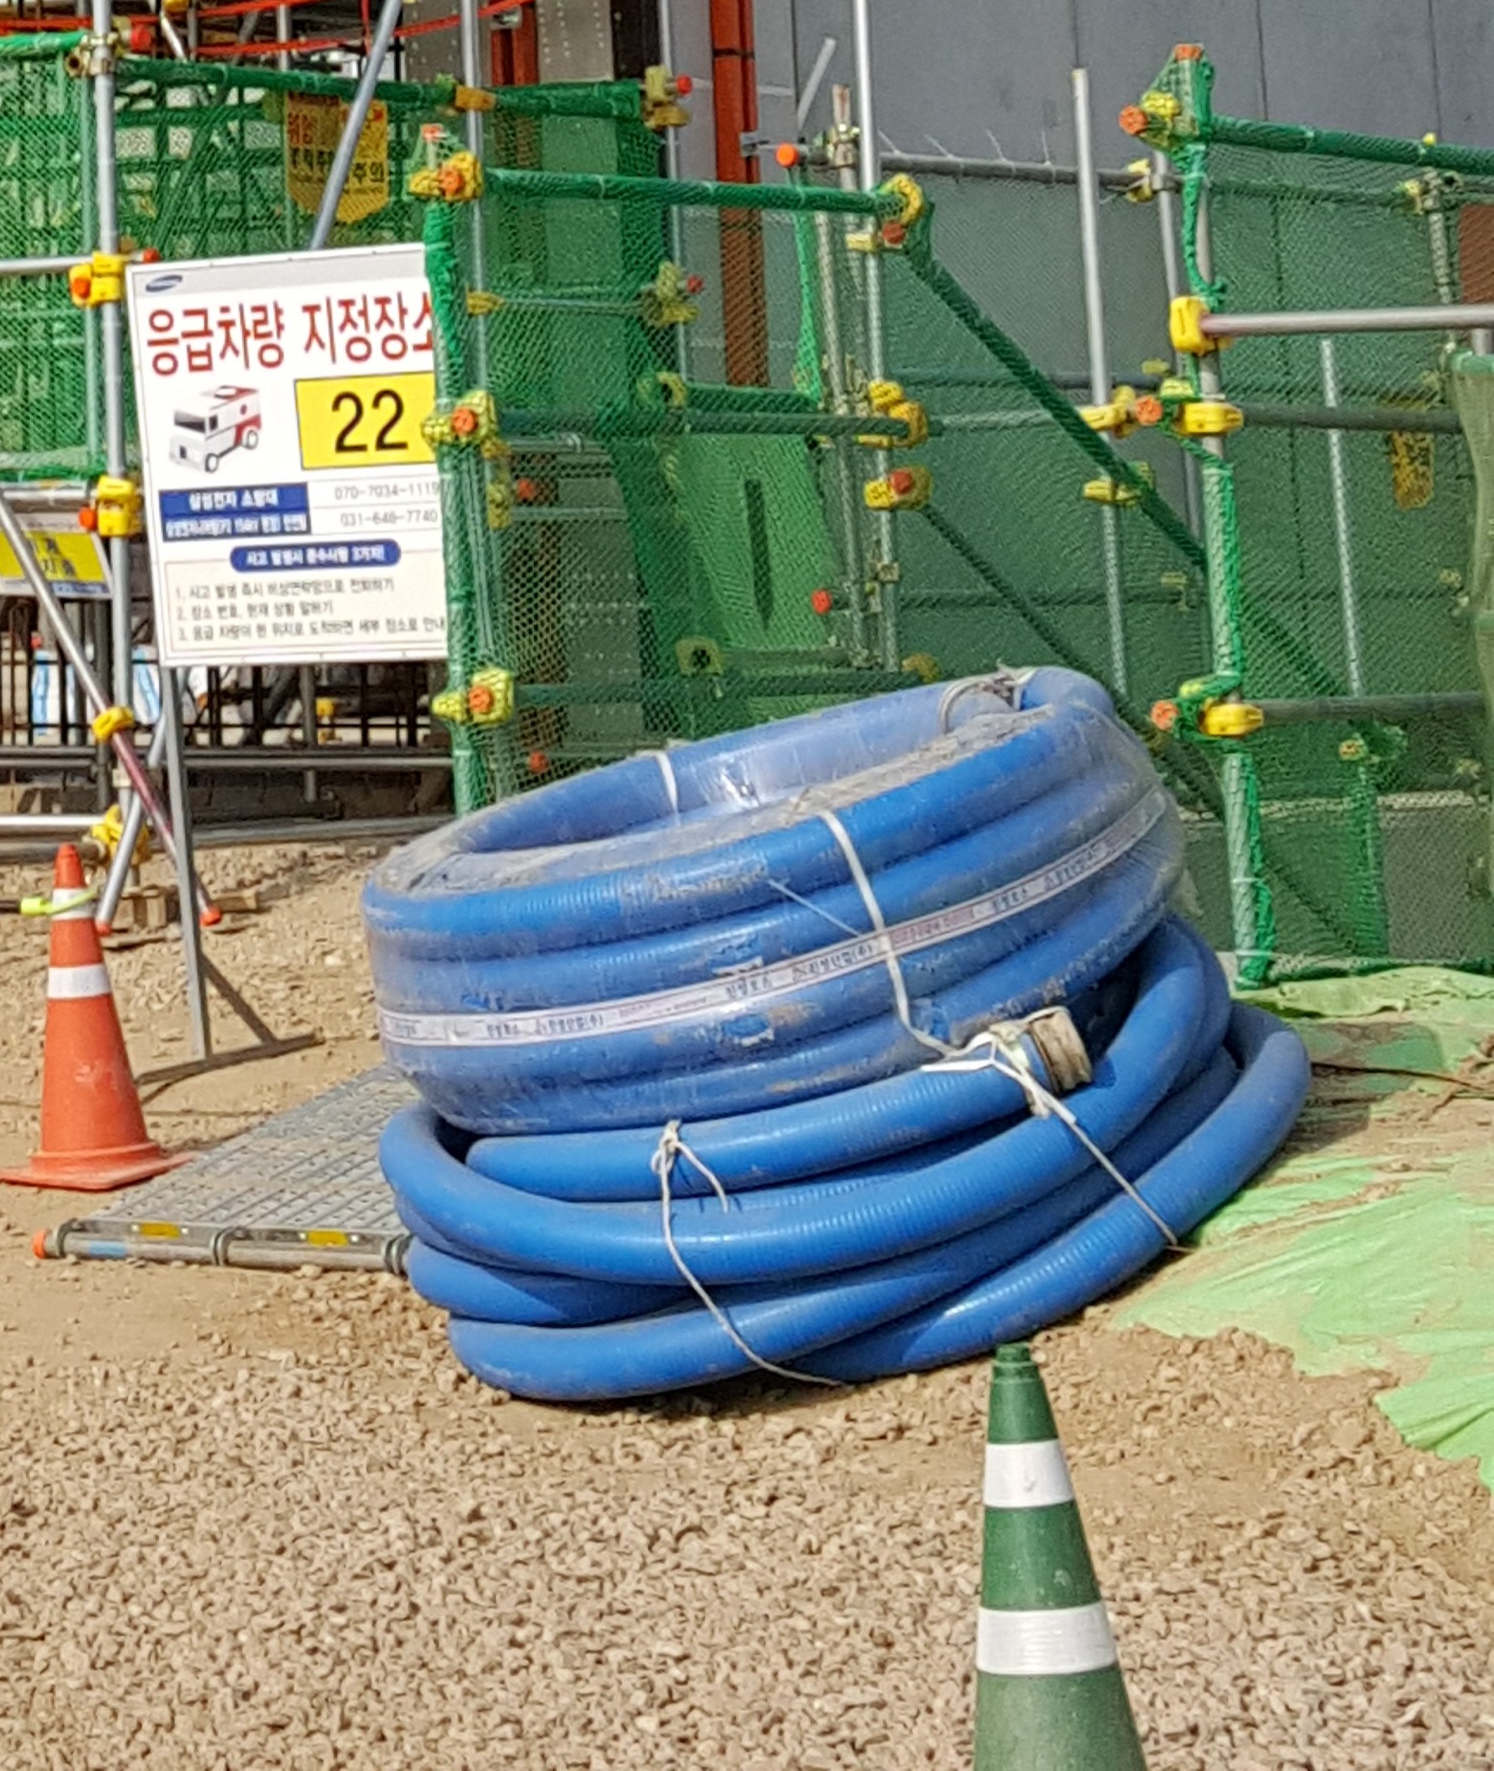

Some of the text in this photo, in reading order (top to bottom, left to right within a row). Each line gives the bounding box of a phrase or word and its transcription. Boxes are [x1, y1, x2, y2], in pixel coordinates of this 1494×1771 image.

[147, 291, 433, 377] 응급차량 지정장소
[331, 389, 409, 454] 22
[189, 584, 212, 600] 사고
